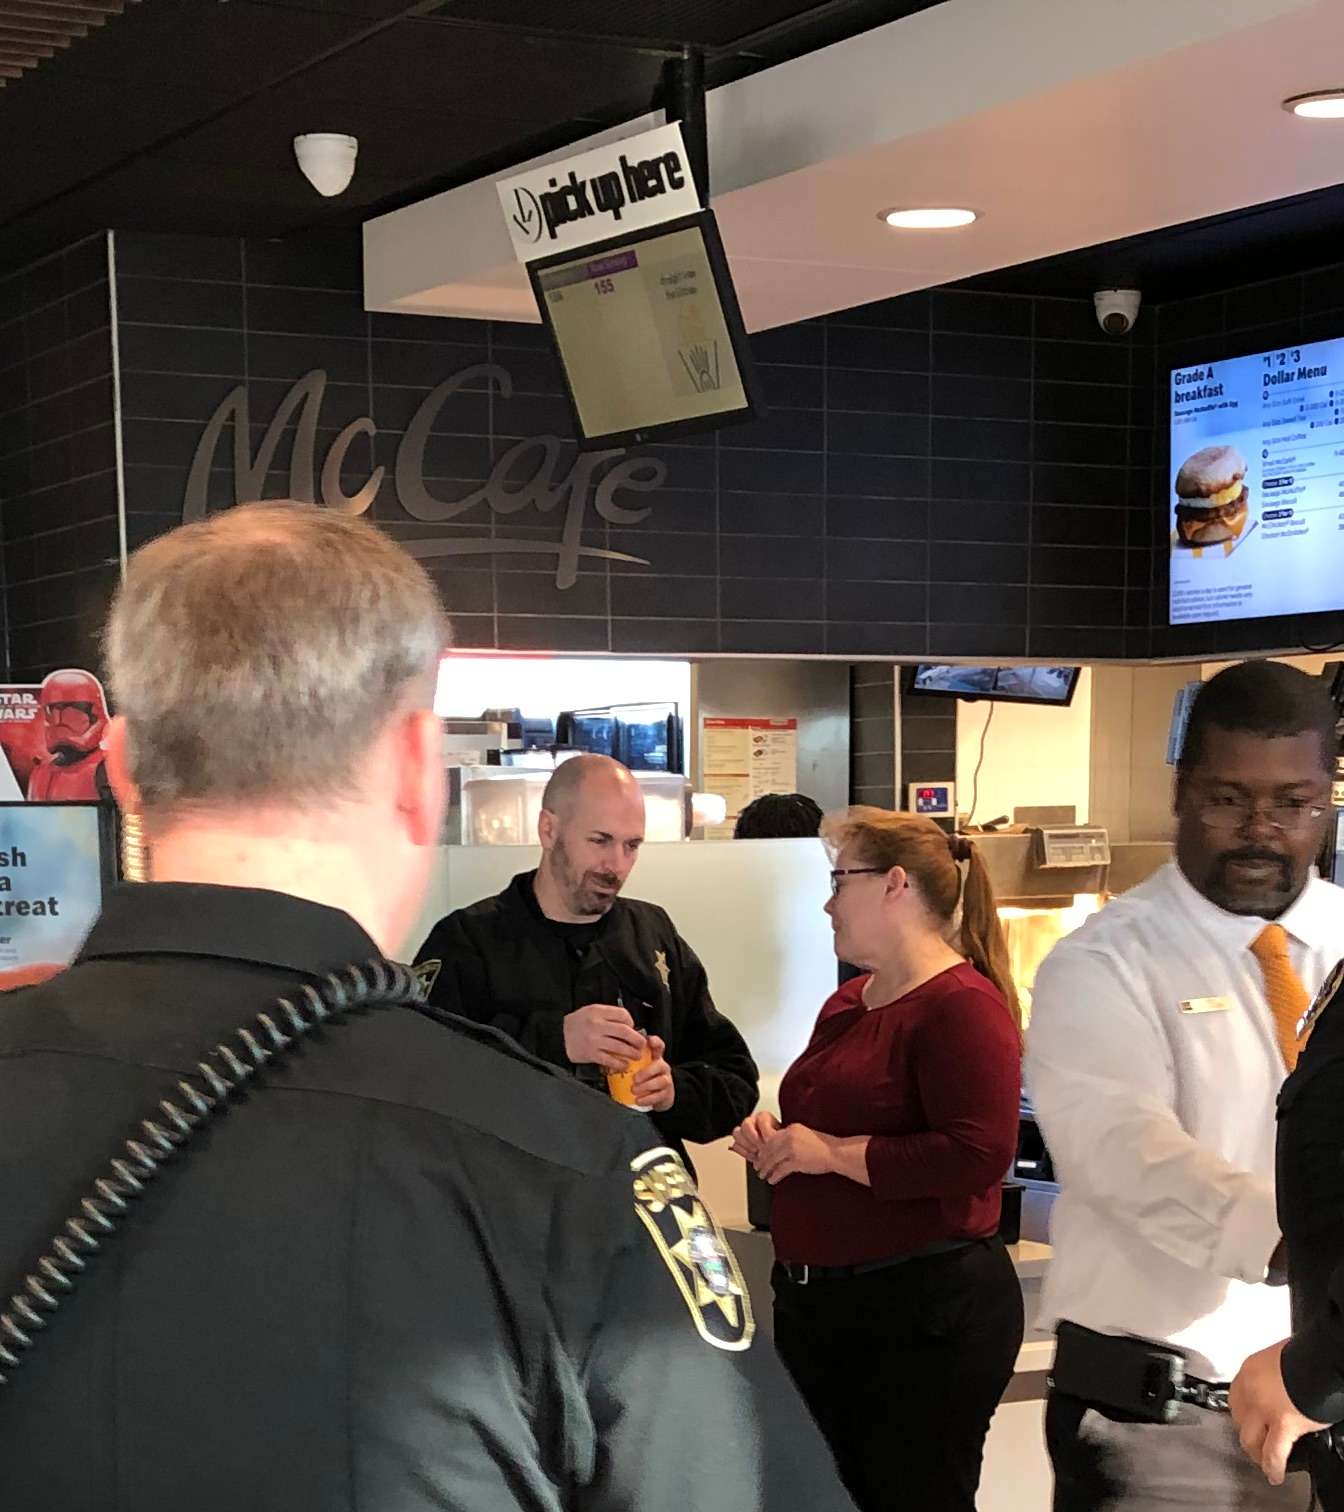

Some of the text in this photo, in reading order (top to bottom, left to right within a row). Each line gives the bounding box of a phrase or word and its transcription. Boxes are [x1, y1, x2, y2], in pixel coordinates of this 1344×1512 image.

[539, 151, 684, 239] pick up here
[594, 279, 614, 295] 155
[1174, 366, 1214, 385] Grade A
[1263, 366, 1328, 387] Dollar Menu
[1174, 383, 1224, 404] breakfast
